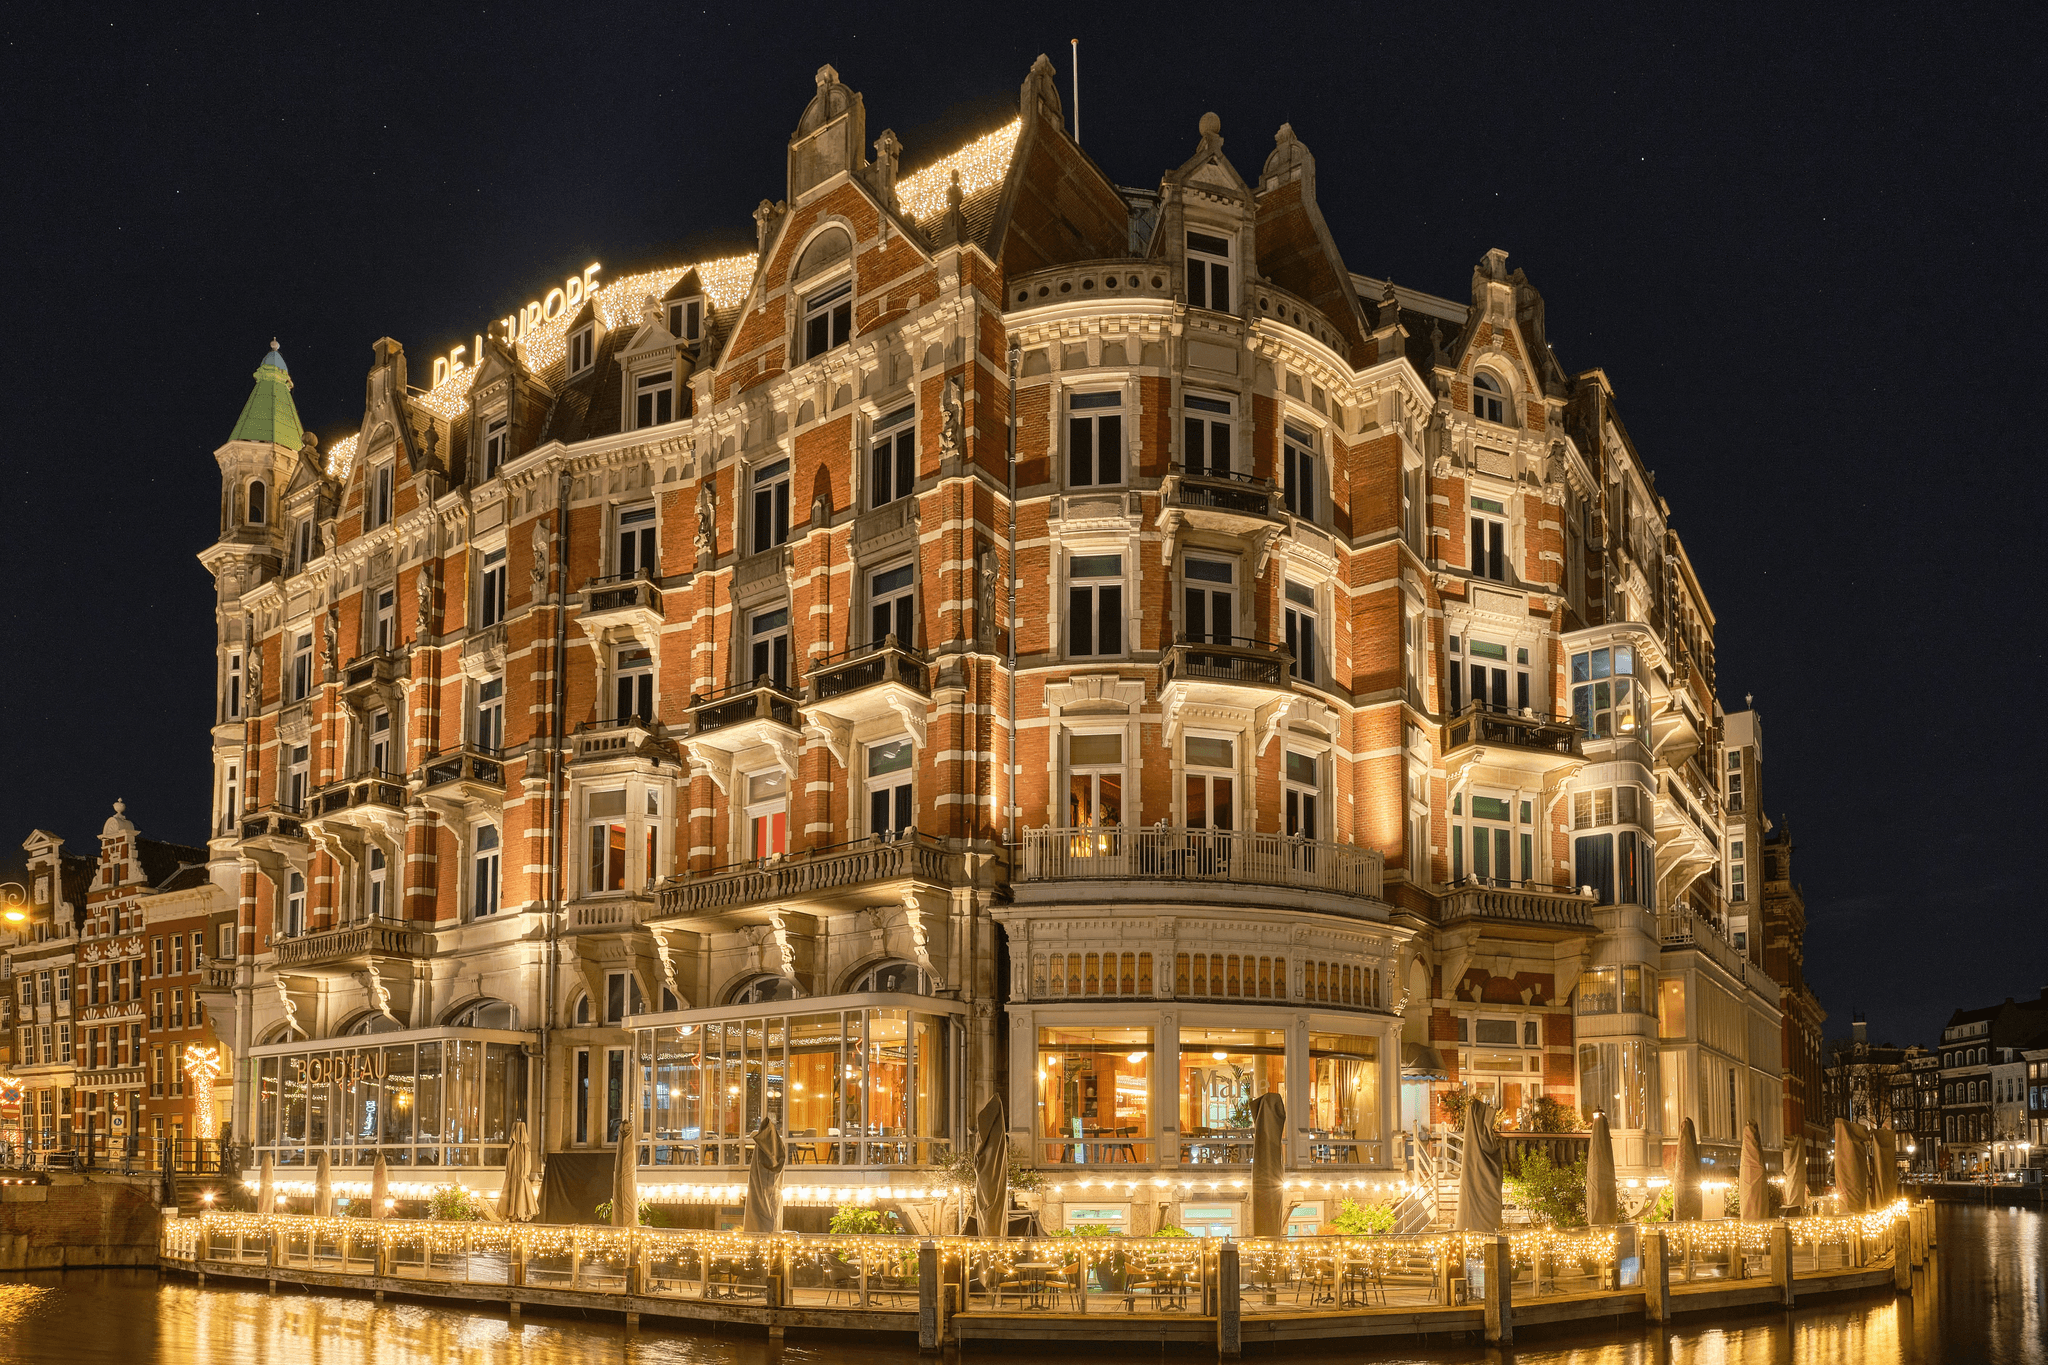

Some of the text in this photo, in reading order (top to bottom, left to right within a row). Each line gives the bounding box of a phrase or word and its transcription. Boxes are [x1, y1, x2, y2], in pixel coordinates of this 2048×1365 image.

[433, 262, 601, 390] DE LUROPE
[297, 1053, 387, 1084] BORD'EAU
